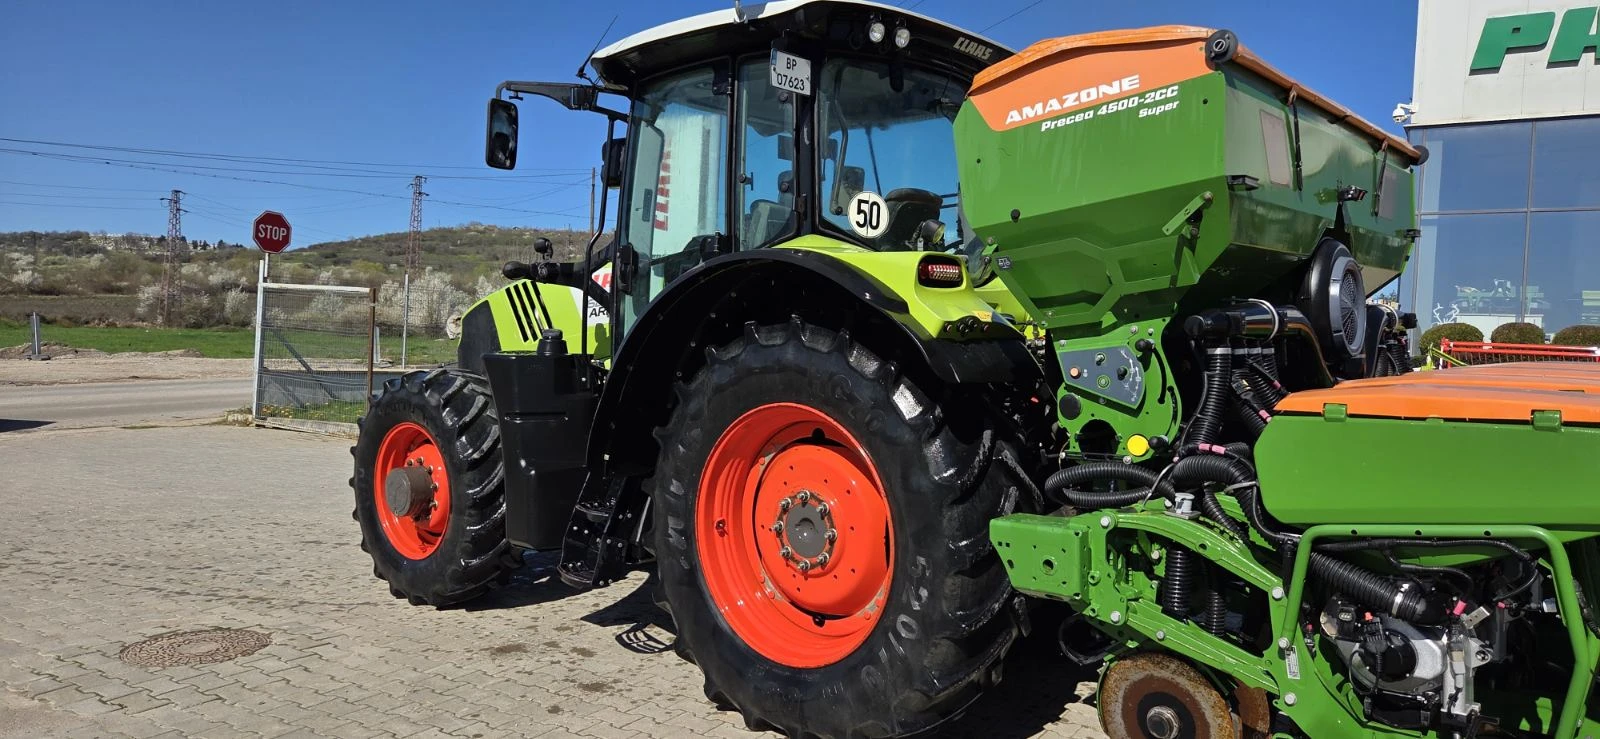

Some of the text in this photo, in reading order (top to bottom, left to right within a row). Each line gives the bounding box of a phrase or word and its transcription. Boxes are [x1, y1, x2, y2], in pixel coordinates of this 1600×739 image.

[953, 36, 993, 60] CLAAS
[786, 57, 798, 70] BP
[776, 73, 806, 91] 07623
[1005, 74, 1141, 125] AMAZONE
[1040, 85, 1180, 132] Precea 4500-2CC
[1138, 100, 1181, 118] Super
[855, 198, 881, 230] 50
[258, 223, 288, 241] STOP
